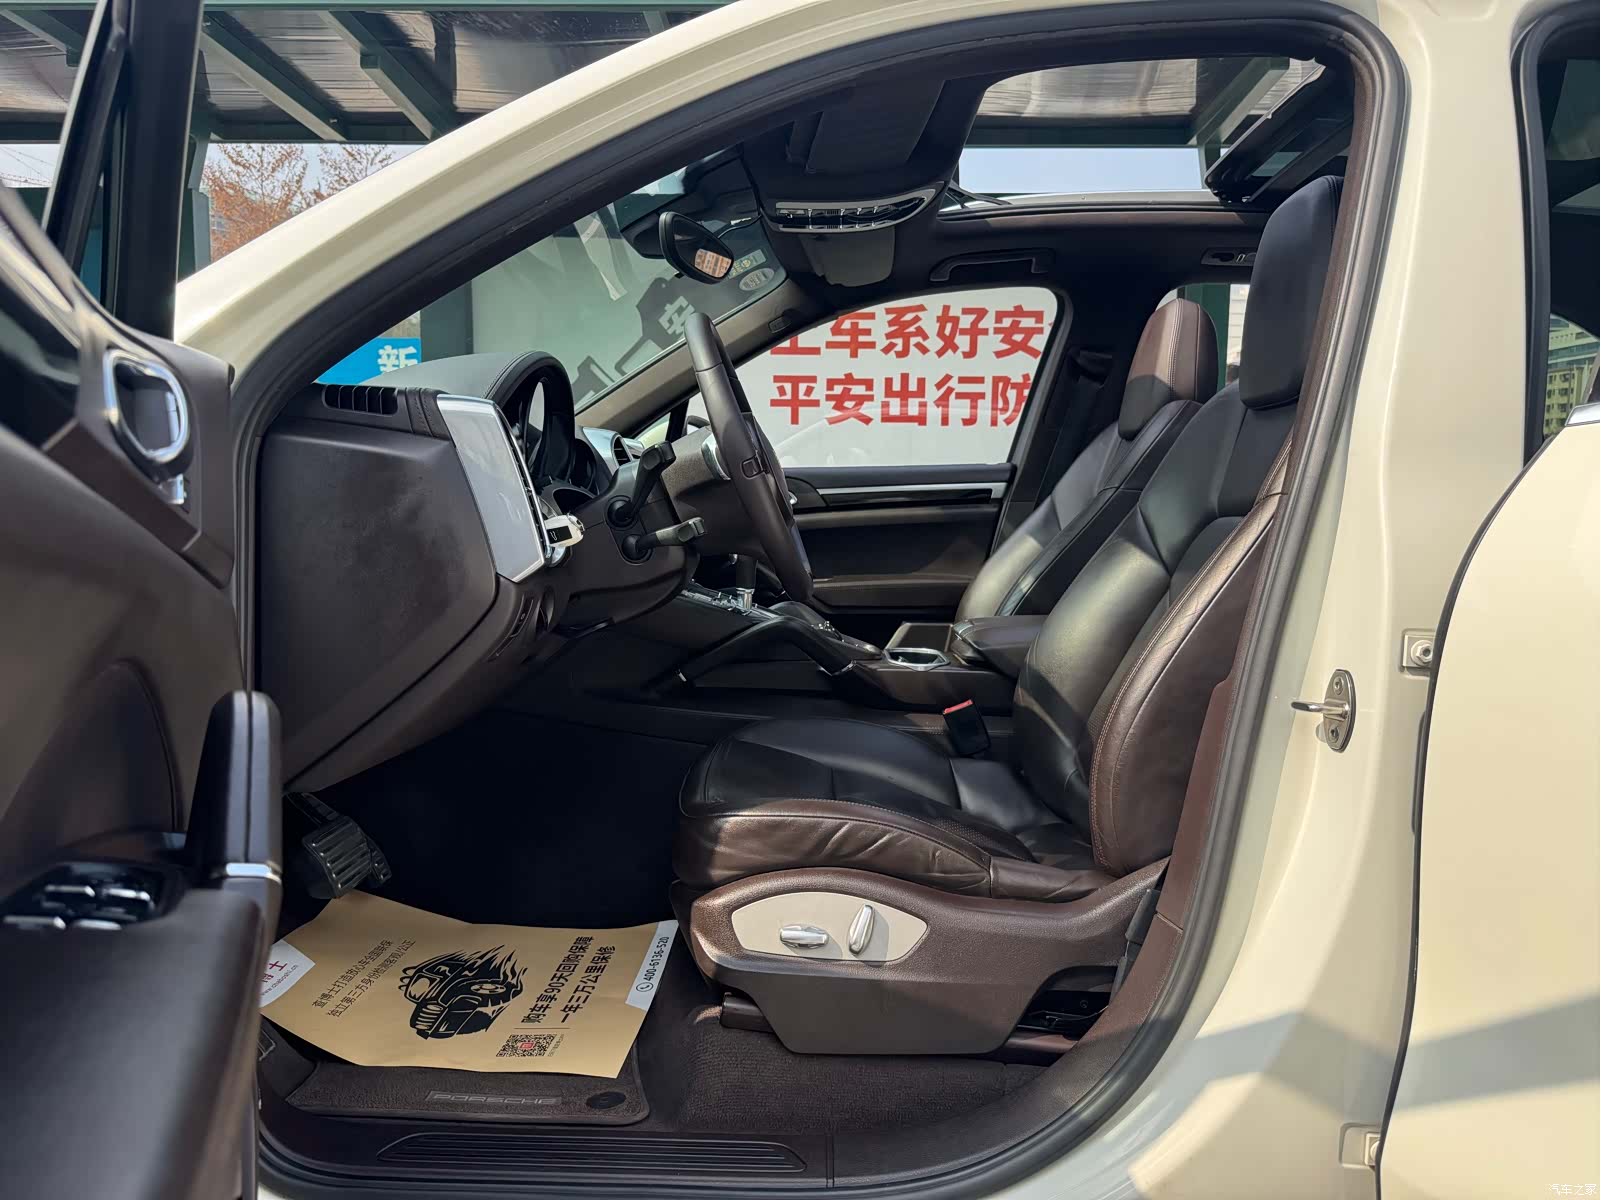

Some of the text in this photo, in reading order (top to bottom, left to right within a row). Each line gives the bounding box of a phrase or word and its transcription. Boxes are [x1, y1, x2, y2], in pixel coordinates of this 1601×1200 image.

[377, 345, 418, 373] 新
[770, 304, 1054, 359] 车系好安
[770, 372, 1033, 427] 平安出行防
[521, 936, 594, 1024] 购车享90天回购保障
[560, 945, 616, 1024] 一年三万公里保修
[643, 936, 669, 982] 400-6136-520
[434, 1093, 560, 1105] PORSCHE
